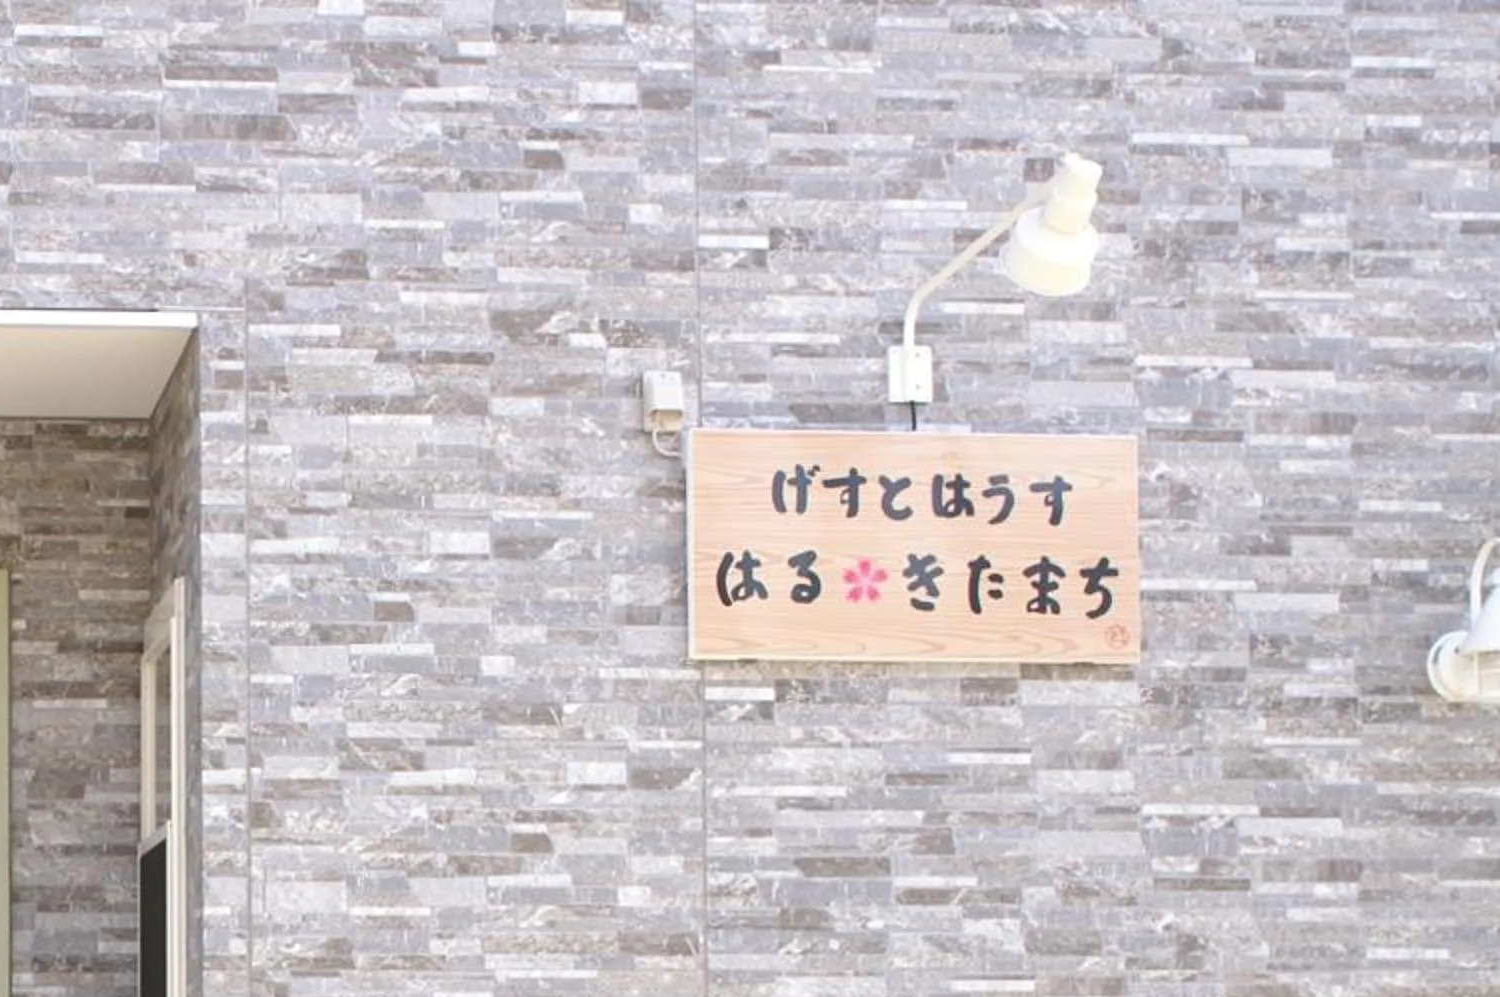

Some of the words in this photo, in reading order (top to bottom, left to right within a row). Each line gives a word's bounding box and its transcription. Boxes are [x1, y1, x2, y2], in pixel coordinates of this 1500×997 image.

[771, 464, 1073, 526] げすとはうす
[716, 550, 822, 606] はる
